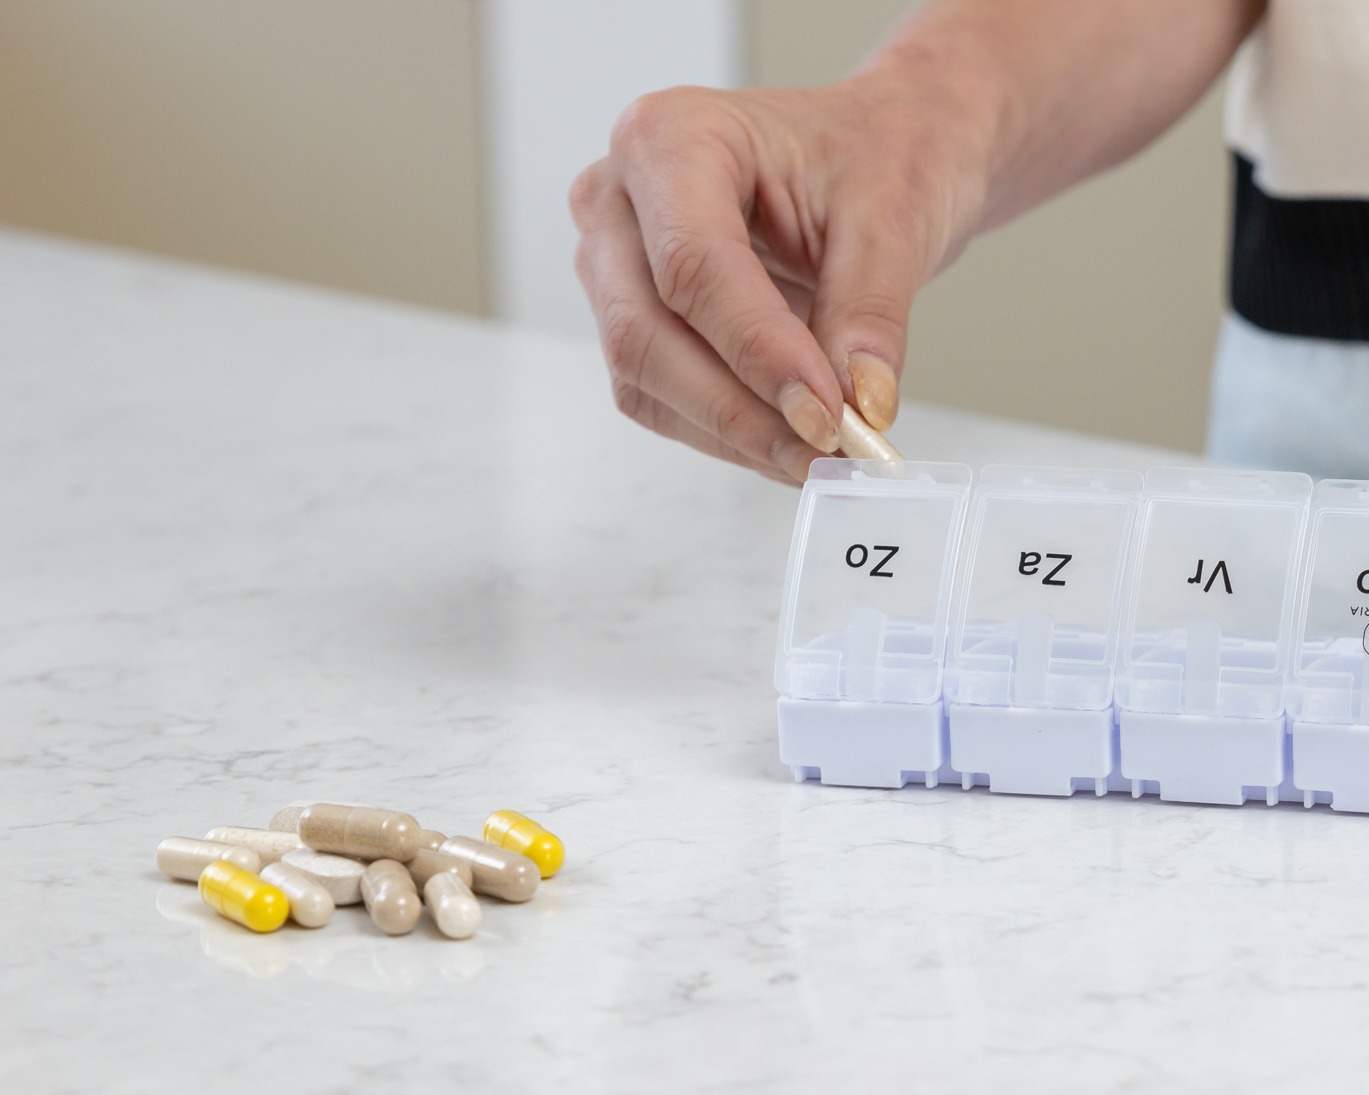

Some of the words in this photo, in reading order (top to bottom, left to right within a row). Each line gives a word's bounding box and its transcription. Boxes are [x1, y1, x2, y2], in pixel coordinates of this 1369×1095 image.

[845, 543, 900, 578] Zo
[1018, 551, 1073, 587] Za
[1187, 559, 1233, 595] Vr
